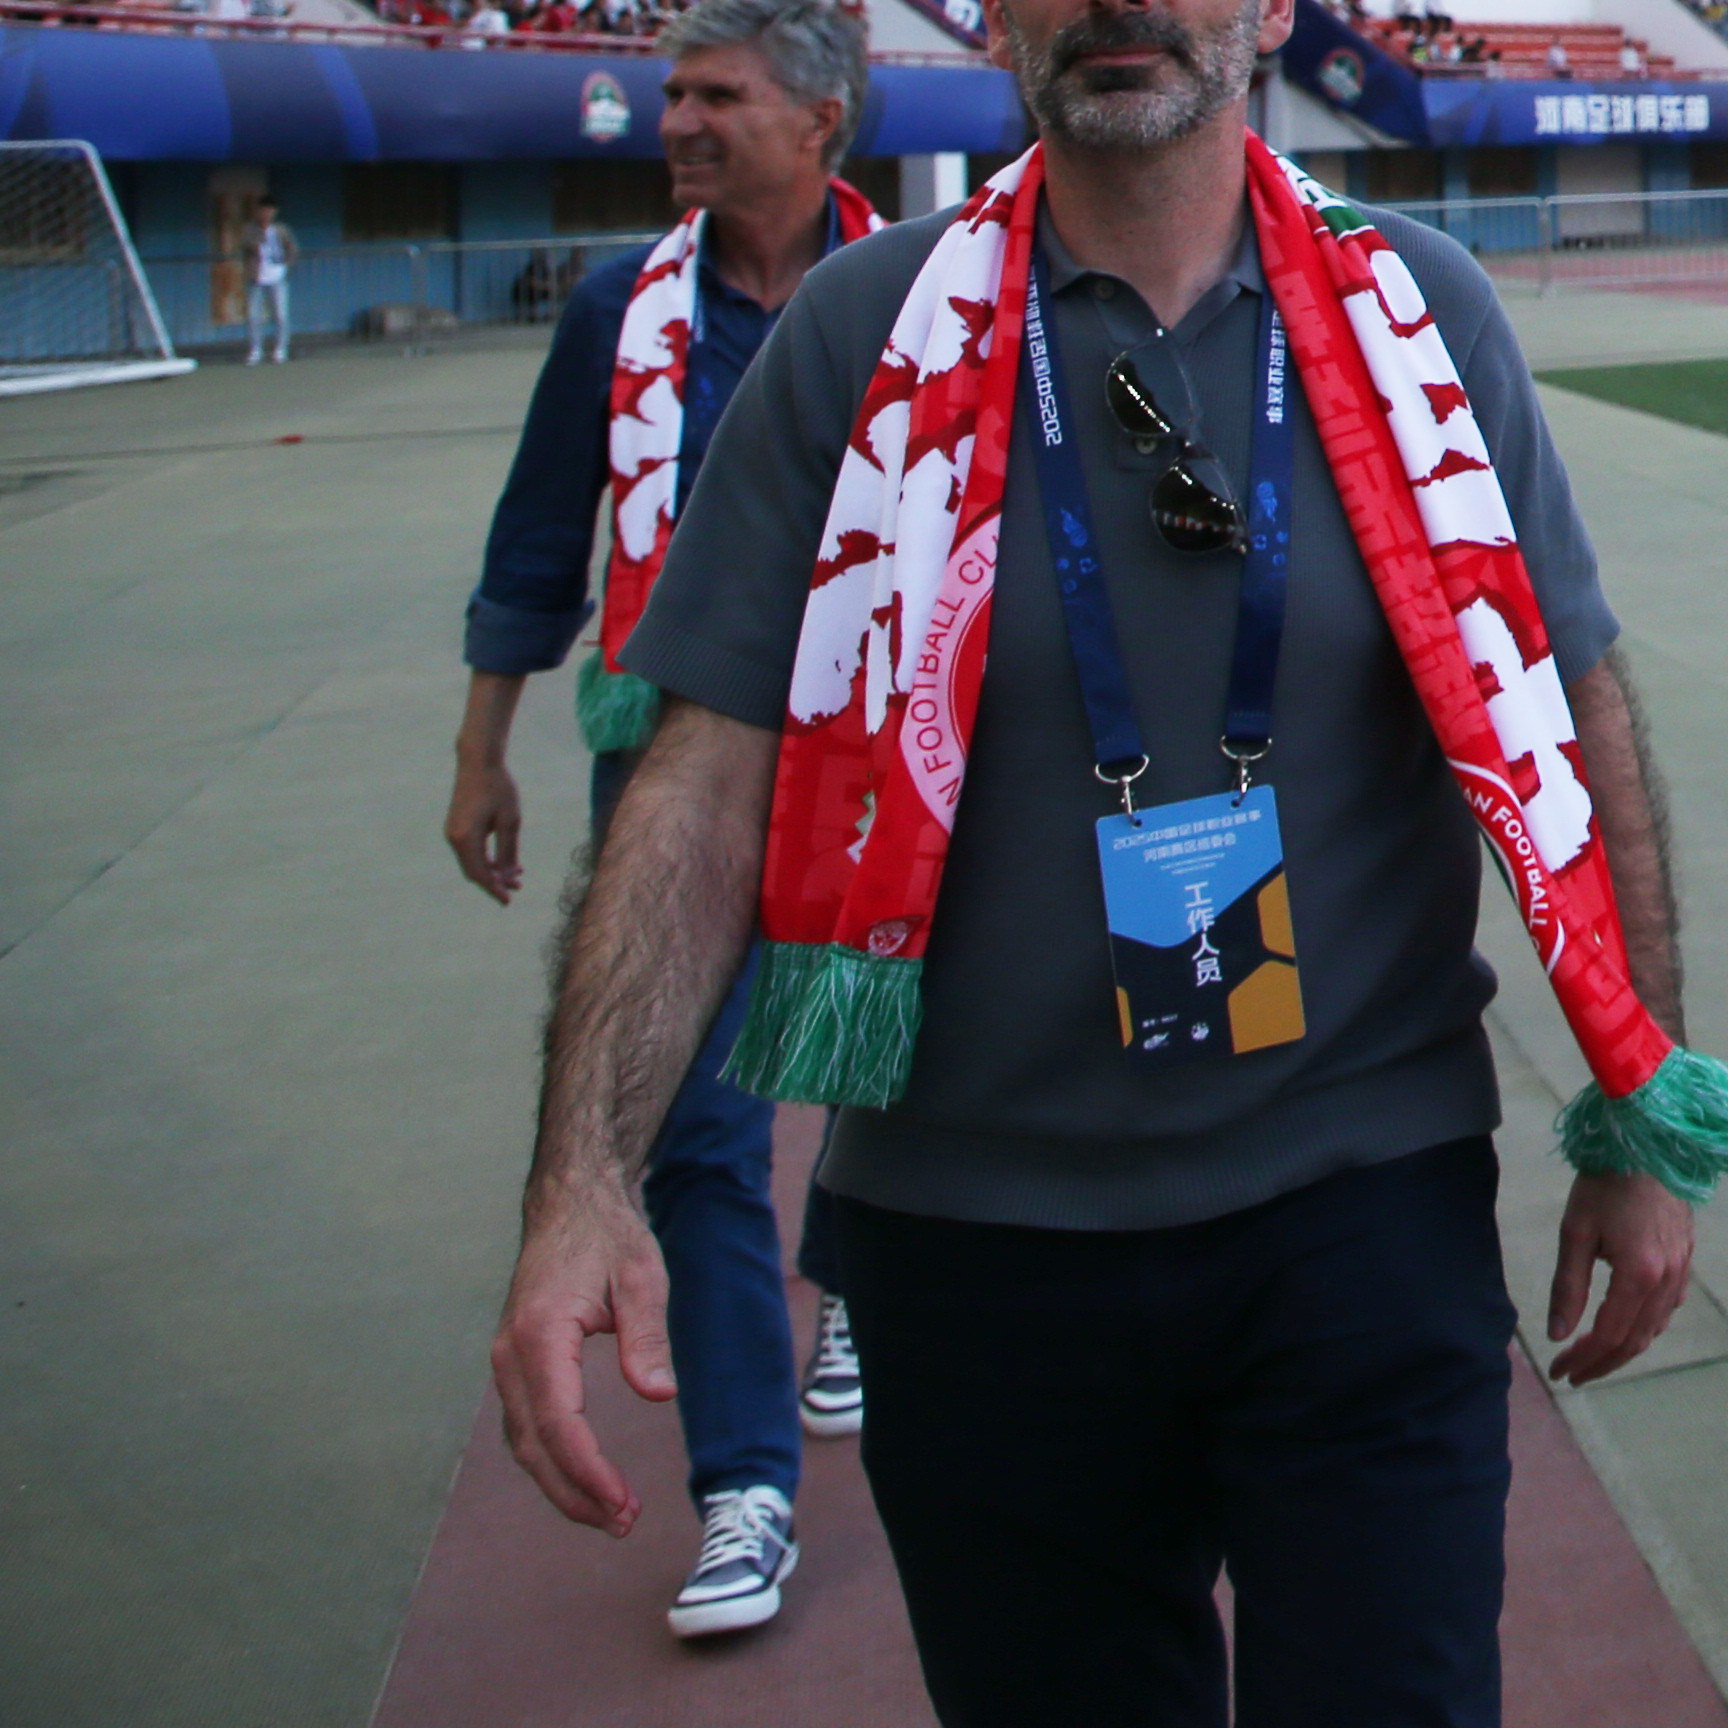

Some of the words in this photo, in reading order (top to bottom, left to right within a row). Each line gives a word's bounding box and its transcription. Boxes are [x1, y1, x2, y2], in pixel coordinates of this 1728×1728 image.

[1534, 95, 1709, 134] 河南足球俱乐部
[911, 597, 965, 774] FOOTBALL
[1491, 805, 1549, 929] FOOTBALL
[1184, 881, 1222, 987] 工作人员
